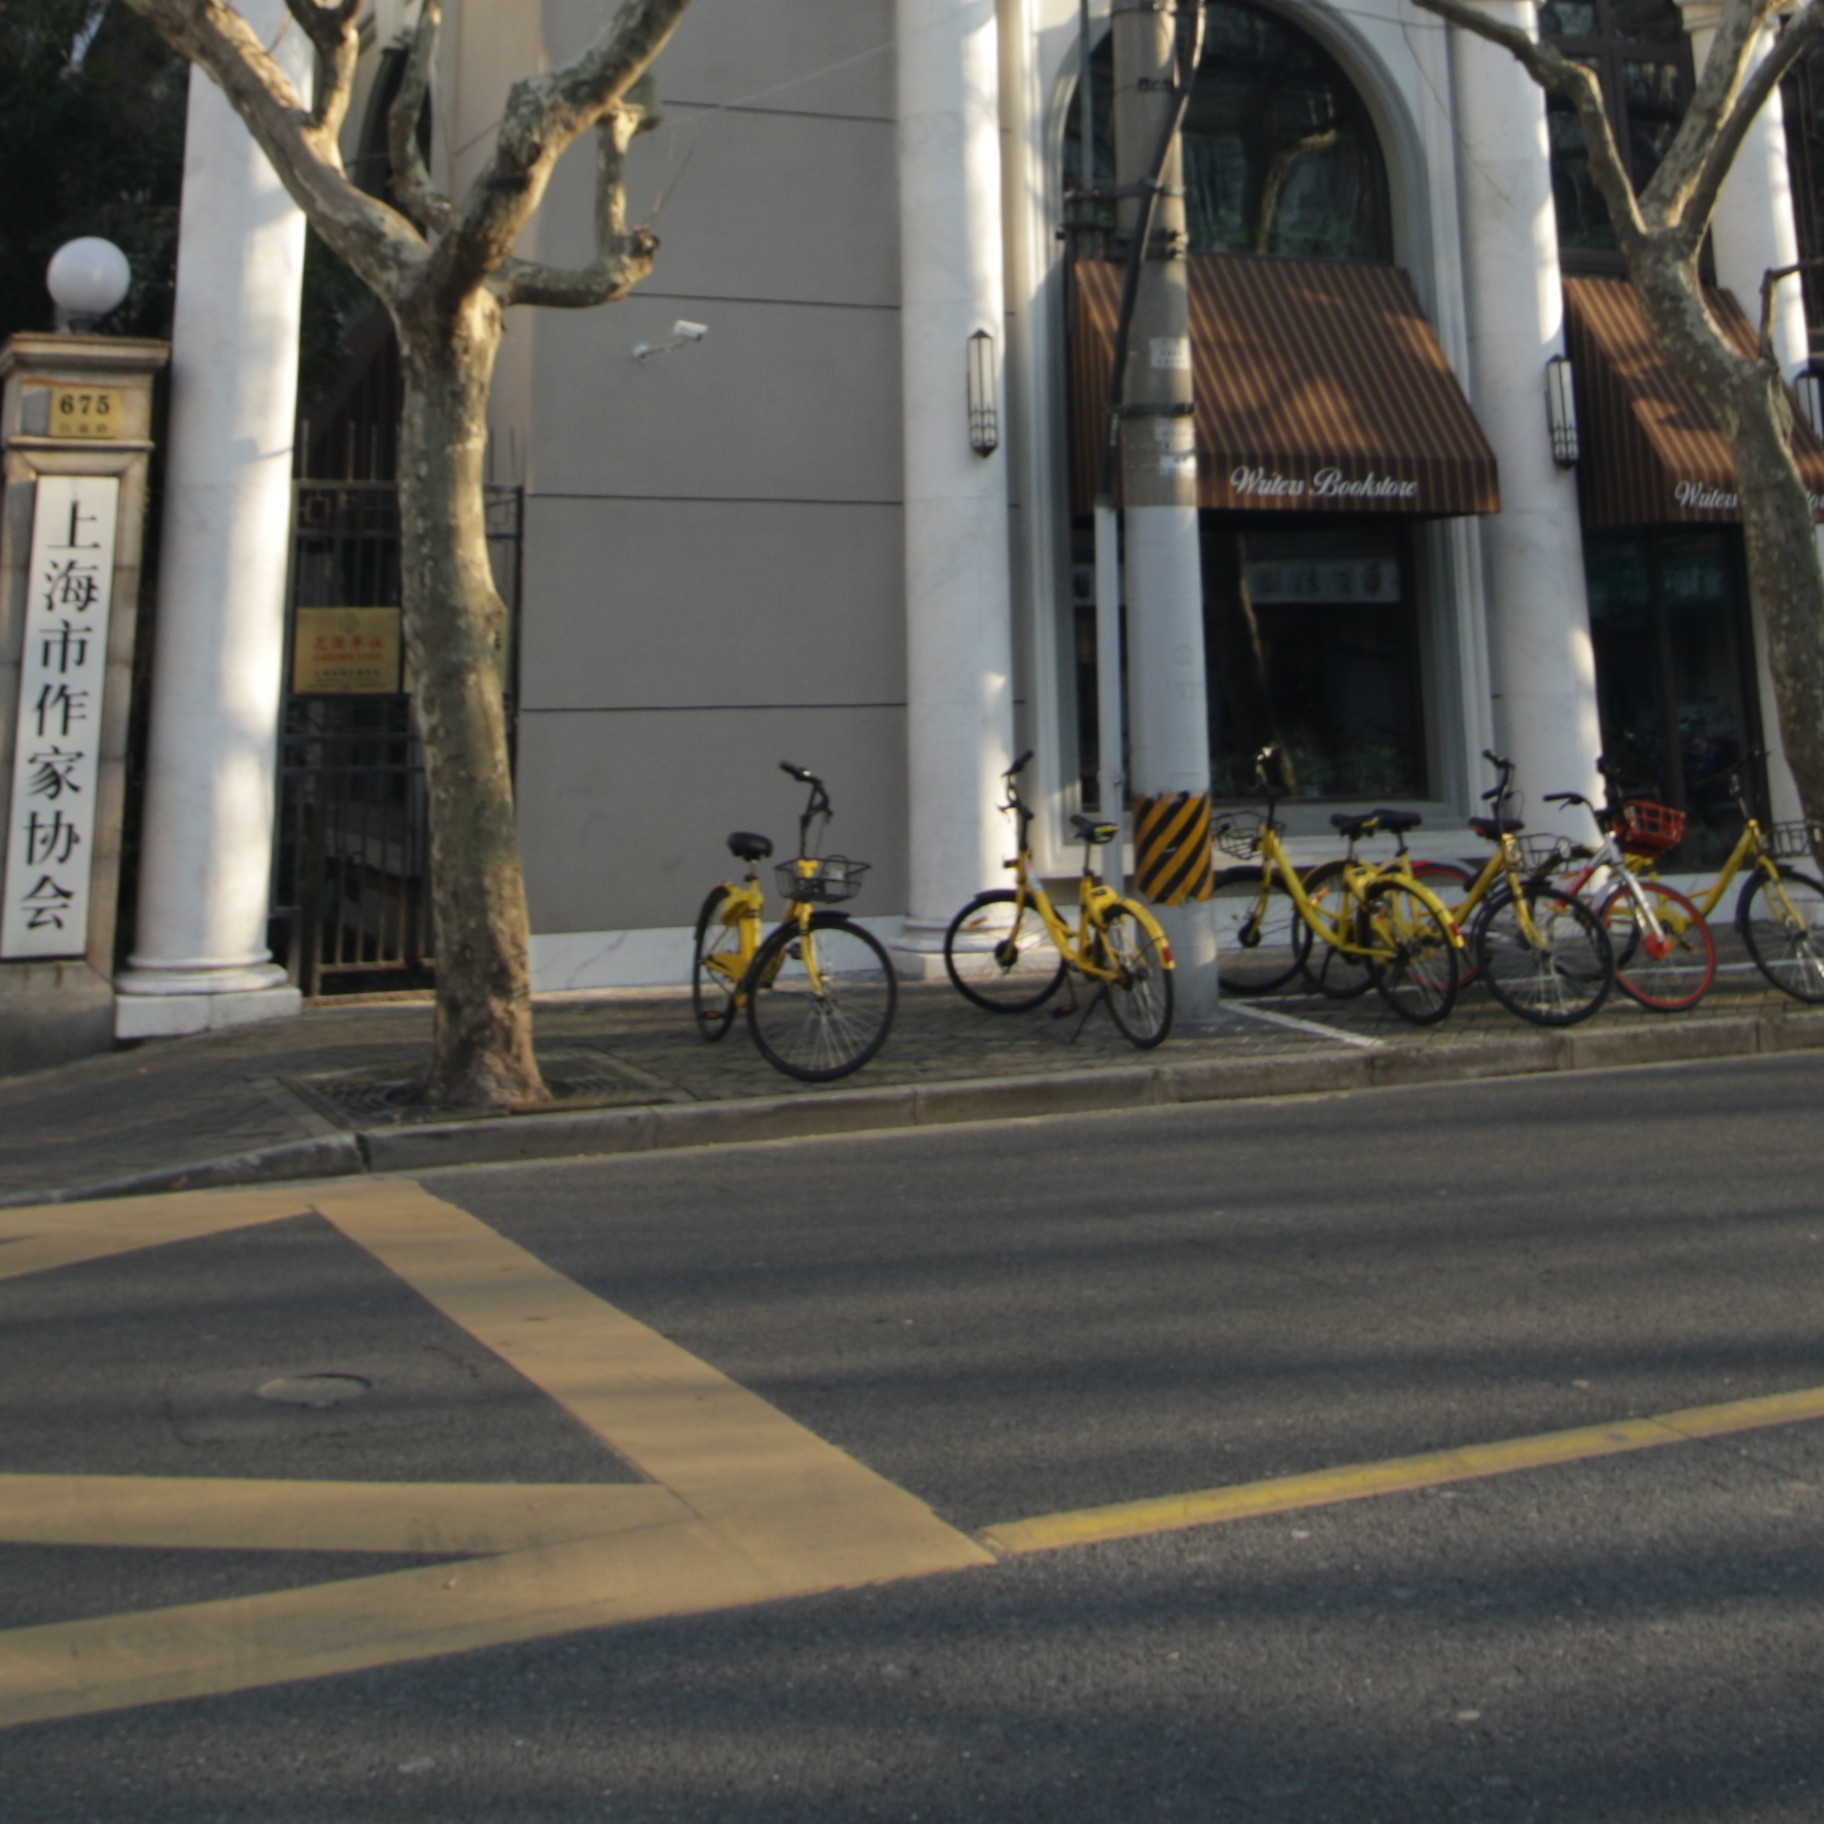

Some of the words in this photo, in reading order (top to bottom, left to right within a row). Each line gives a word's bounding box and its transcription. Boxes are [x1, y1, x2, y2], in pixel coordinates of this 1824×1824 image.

[60, 394, 110, 415] 675
[1230, 465, 1305, 496] Writers
[1308, 467, 1418, 497] Bookstore
[1674, 480, 1739, 508] Writers
[19, 499, 102, 931] 上海市作家协会
